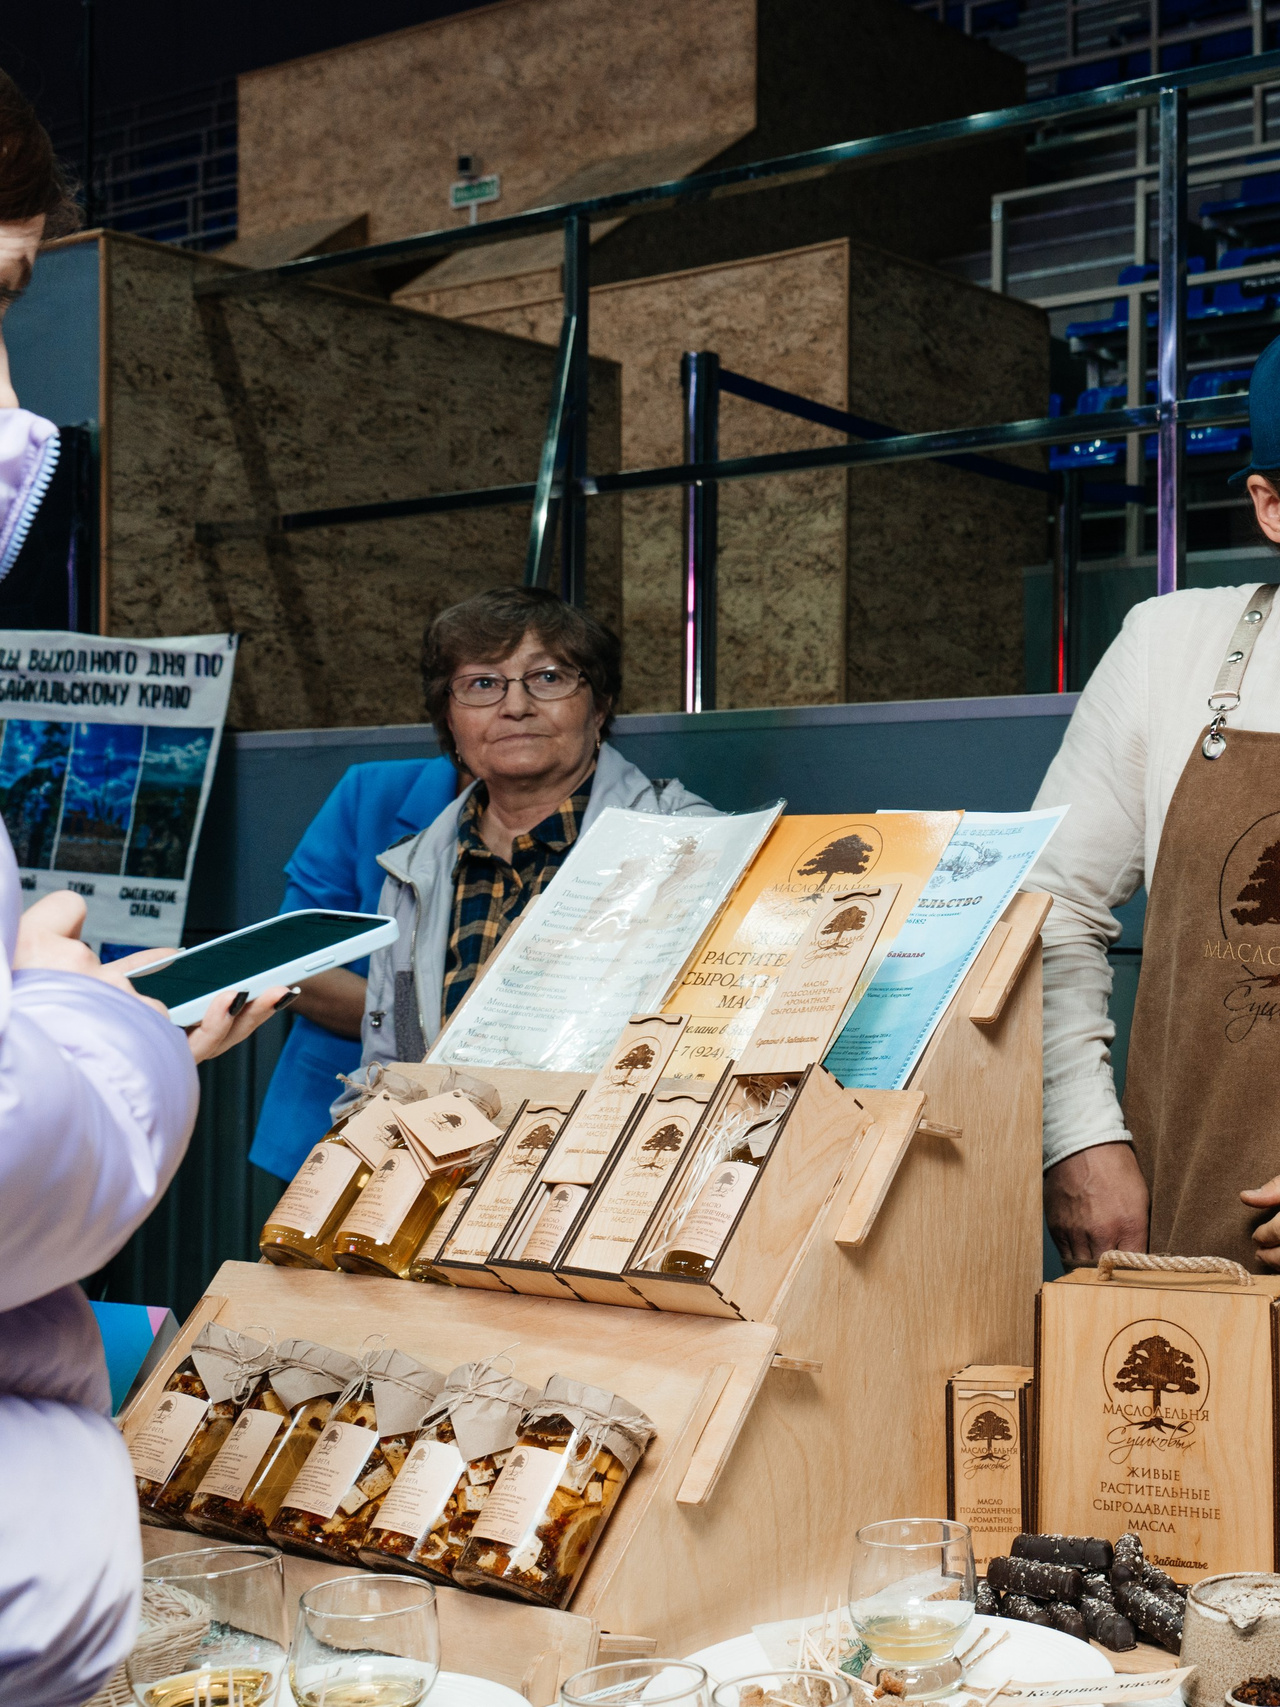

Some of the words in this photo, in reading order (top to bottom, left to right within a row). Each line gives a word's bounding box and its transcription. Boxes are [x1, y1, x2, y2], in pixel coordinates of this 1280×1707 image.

[28, 649, 138, 674] ВЫХОДНОГО
[147, 651, 187, 676] ДНЯ
[195, 652, 223, 678] ПО
[138, 683, 192, 709] КРАЮ
[917, 895, 983, 909] ЕЛЬСТВО
[701, 951, 791, 968] РАСТИТЕ
[886, 950, 926, 958] байкалье
[803, 980, 829, 988] МАСЛО
[780, 987, 843, 998] ПОДСОЛНЕЧНОЕ
[784, 997, 830, 1006] АРОМАТНОЕ
[770, 1004, 835, 1015] СЫРОДАВЛЕННОЕ
[685, 1024, 719, 1035] елано
[690, 1045, 725, 1062] (924)
[1102, 1403, 1210, 1422] МАСЛОДЕЛЬНЯ
[1106, 1421, 1197, 1465] Сушковых
[961, 1447, 1018, 1455] МАСЛОДЕЛЬНЯ
[1127, 1466, 1181, 1481] ЖИВЫЕ
[1100, 1481, 1211, 1501] РАСТИТЕЛЬНЫЕ
[977, 1498, 1003, 1506] МАСЛО
[960, 1507, 1021, 1515] ПОДСОЛНЕЧНОЕ
[1093, 1499, 1221, 1520] СЫРОДАВЛЕННЫЕ
[968, 1516, 1013, 1524] АРОМАТНОЕ
[1128, 1518, 1176, 1534] МАСЛА
[969, 1525, 1022, 1533] РОДАВЛЕННОЕ
[1152, 1554, 1209, 1570] Забайкалье
[1026, 1685, 1108, 1698] Кедровое
[1116, 1677, 1171, 1689] масло
